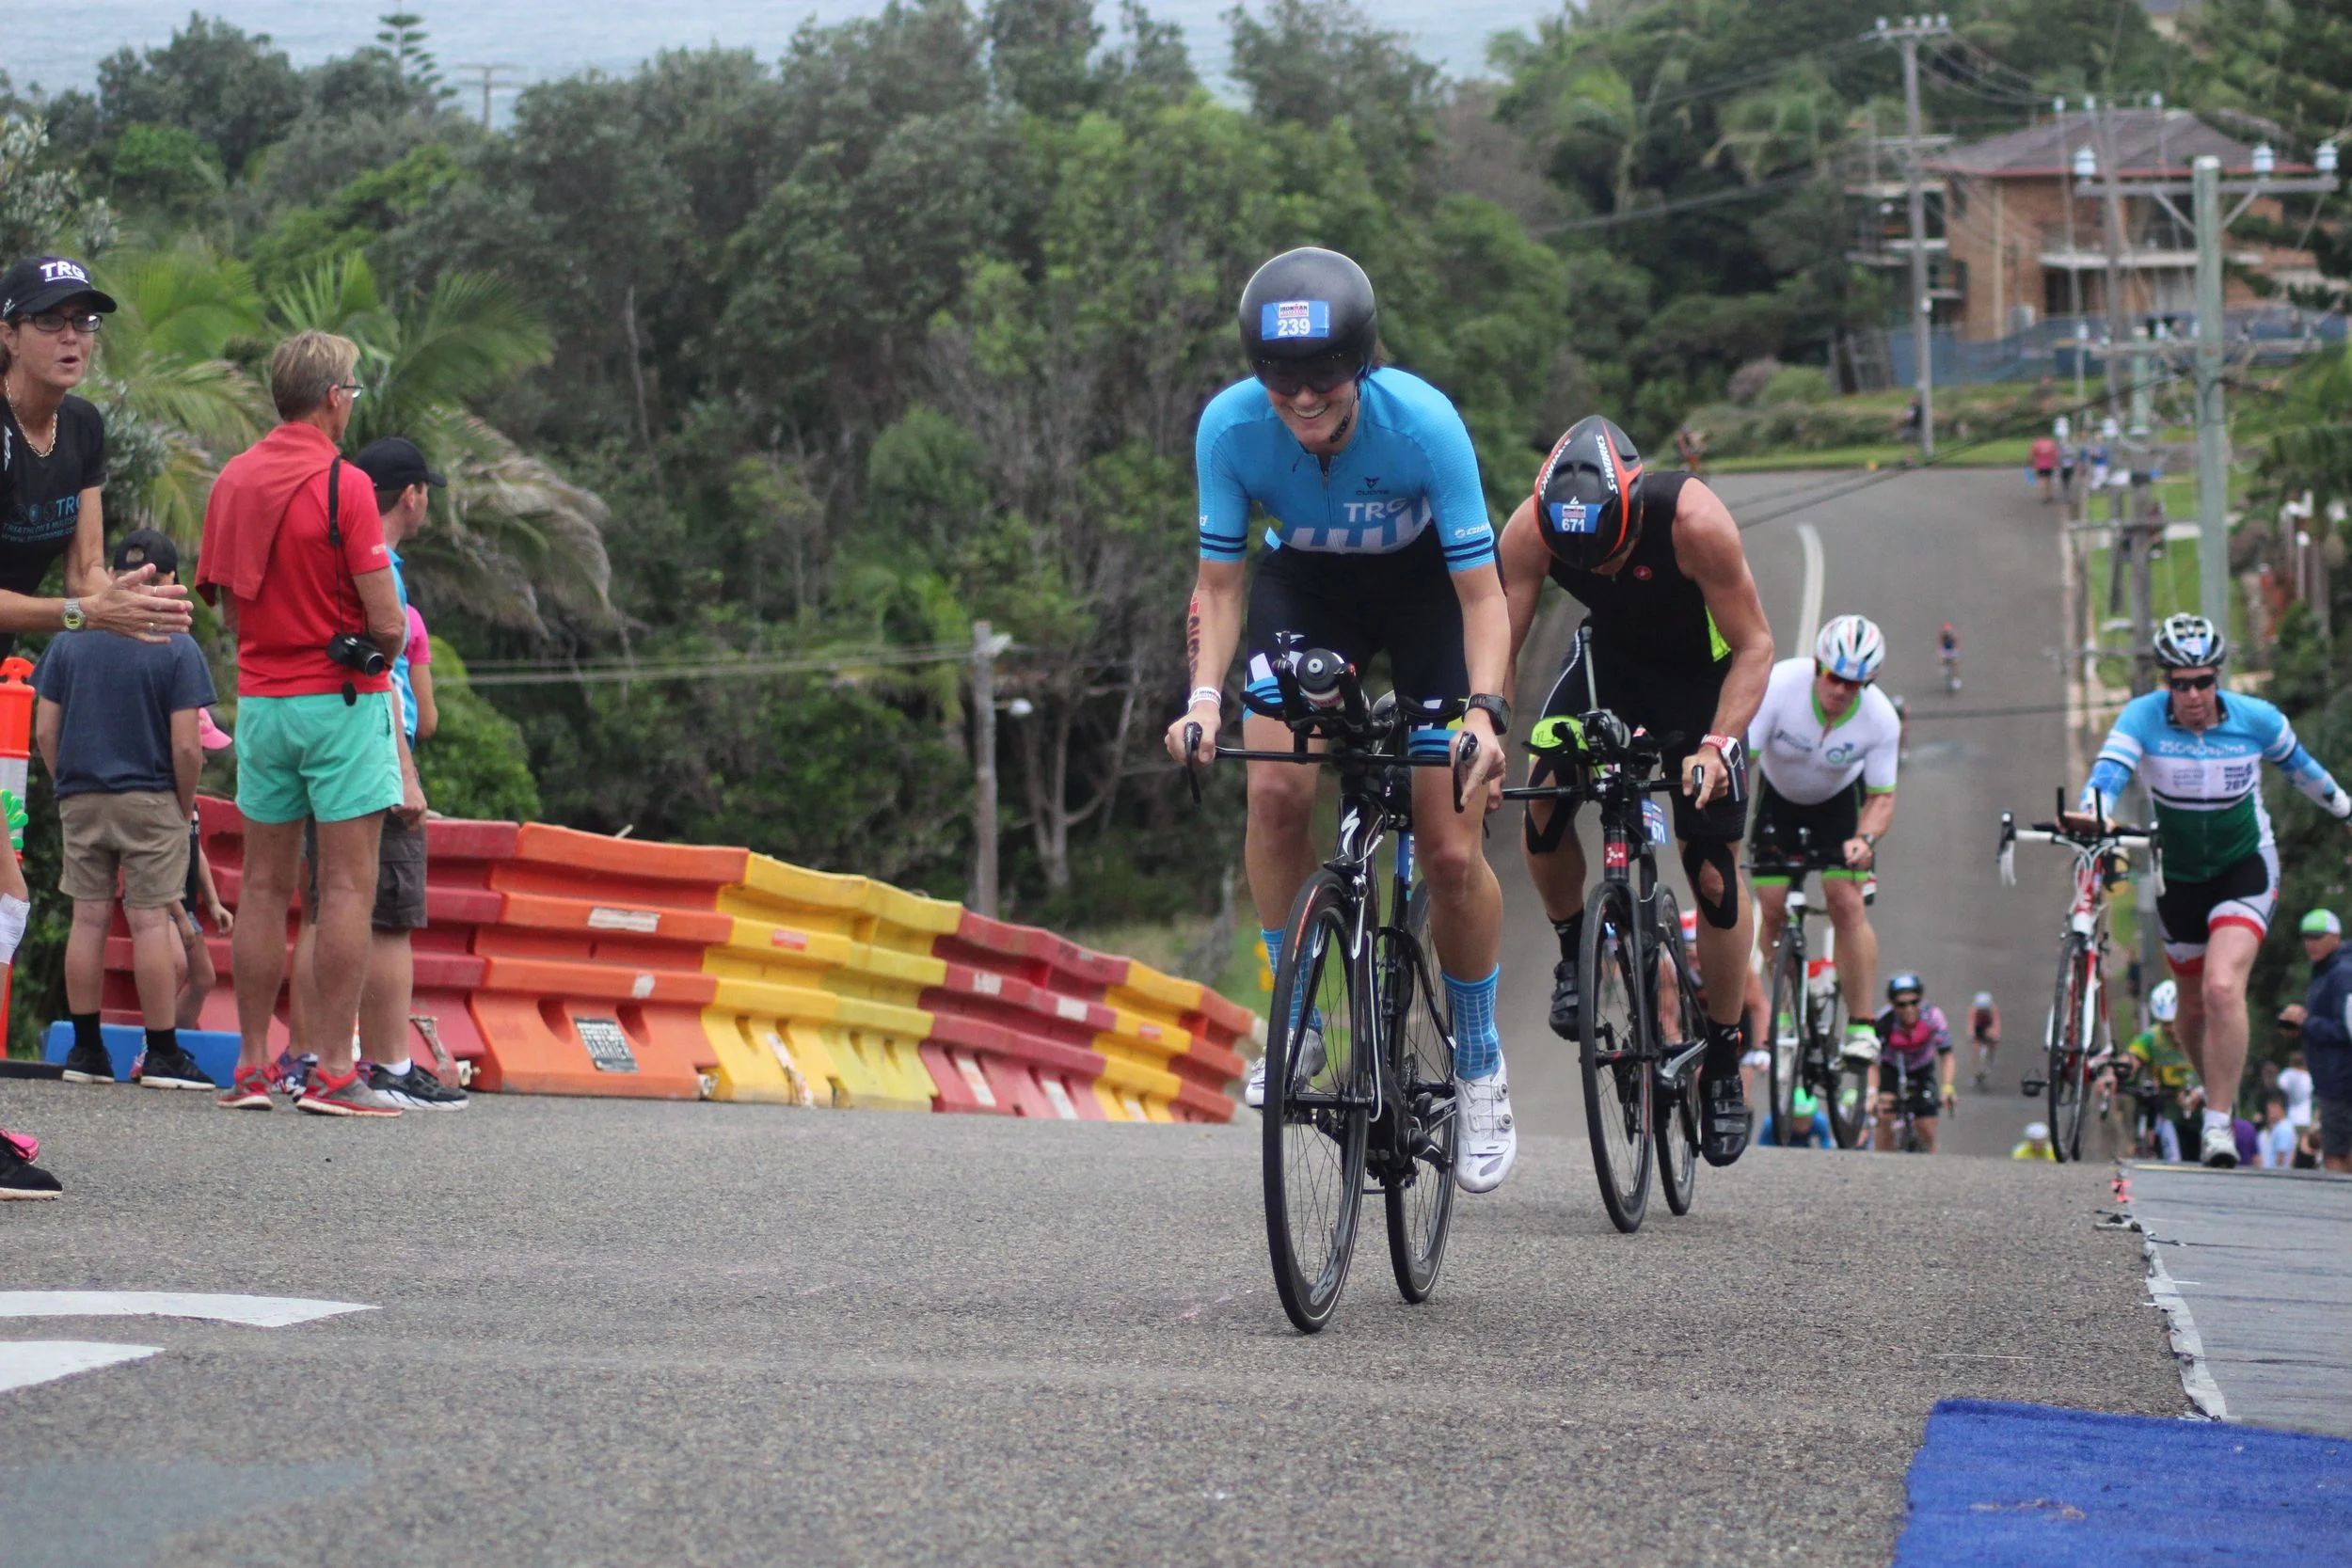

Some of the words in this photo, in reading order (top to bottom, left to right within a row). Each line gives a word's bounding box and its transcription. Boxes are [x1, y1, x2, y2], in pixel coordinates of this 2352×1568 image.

[40, 261, 85, 278] TRG
[1279, 318, 1310, 336] 239
[1596, 435, 1618, 494] S-WORKS
[1343, 498, 1406, 523] TRG
[1562, 518, 1585, 532] 671
[1651, 820, 1666, 844] 671
